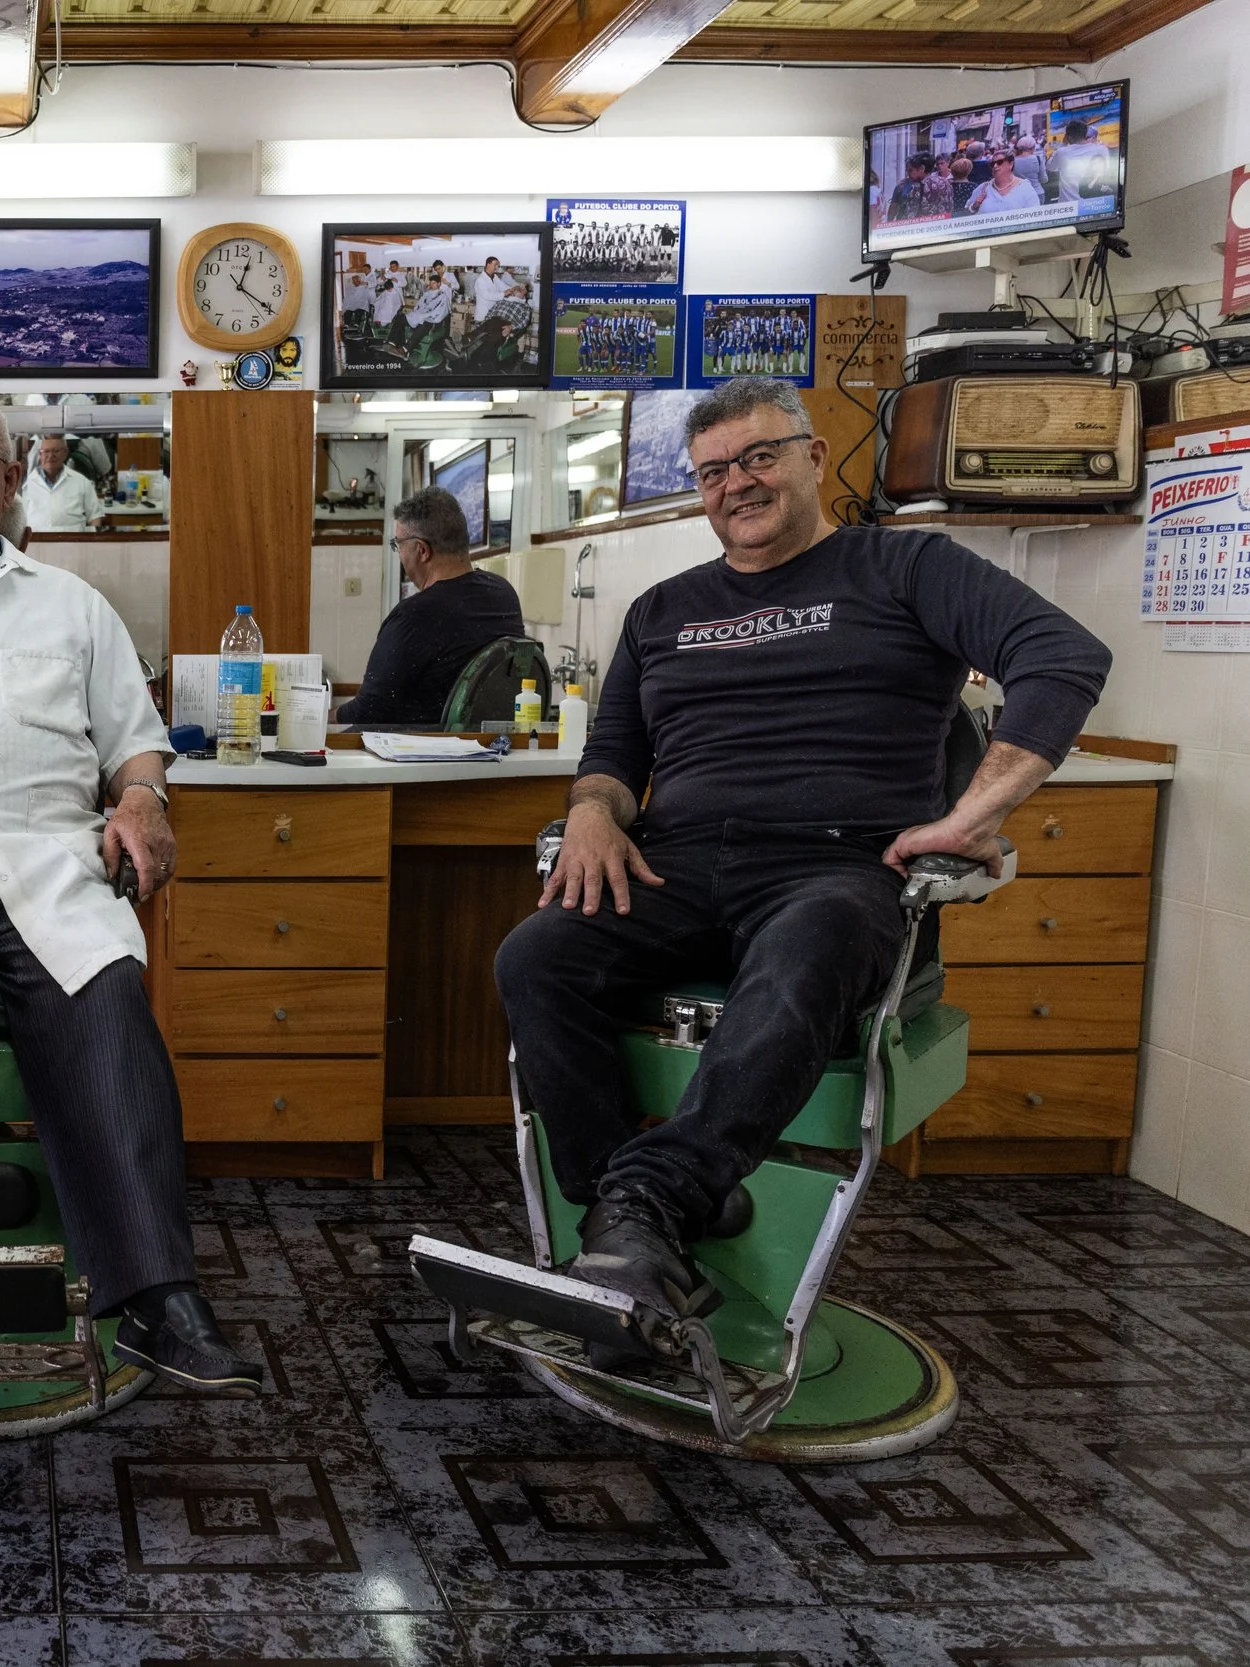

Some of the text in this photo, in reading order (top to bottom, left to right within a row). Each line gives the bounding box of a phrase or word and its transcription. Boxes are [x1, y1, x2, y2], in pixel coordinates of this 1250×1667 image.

[954, 218, 985, 228] MARGEM
[985, 216, 1004, 224] PARA
[1005, 211, 1043, 221] ABSORVER
[1044, 206, 1074, 216] DÉFICES
[217, 248, 230, 262] 11
[234, 244, 250, 258] 12
[257, 251, 263, 264] 1
[204, 262, 220, 276] 10
[268, 264, 278, 278] 2
[196, 279, 207, 293] 9
[272, 284, 282, 297] 3
[201, 298, 211, 312] 8
[263, 301, 273, 316] 4
[214, 312, 224, 326] 7
[231, 319, 242, 333] 6
[250, 315, 260, 329] 5
[823, 333, 898, 345] commercia
[344, 362, 375, 370] Fevereiro
[1151, 475, 1230, 515] PEIXEFRIO
[1162, 516, 1207, 527] JUNHO
[1182, 537, 1188, 549] 1
[1200, 536, 1207, 548] 2
[1219, 535, 1228, 547] 3
[1241, 534, 1250, 546] F
[1145, 551, 1250, 567] 24 7 8 9 F 11
[1144, 566, 1250, 582] 25 14 15 16 17 18
[1143, 583, 1250, 597] 26 21 22 23 24 25
[806, 602, 833, 612] URBAN
[1142, 600, 1205, 613] 27 28 29 30
[677, 608, 832, 643] BROOKLYN
[755, 626, 830, 645] SUPERIOR-STYLE
